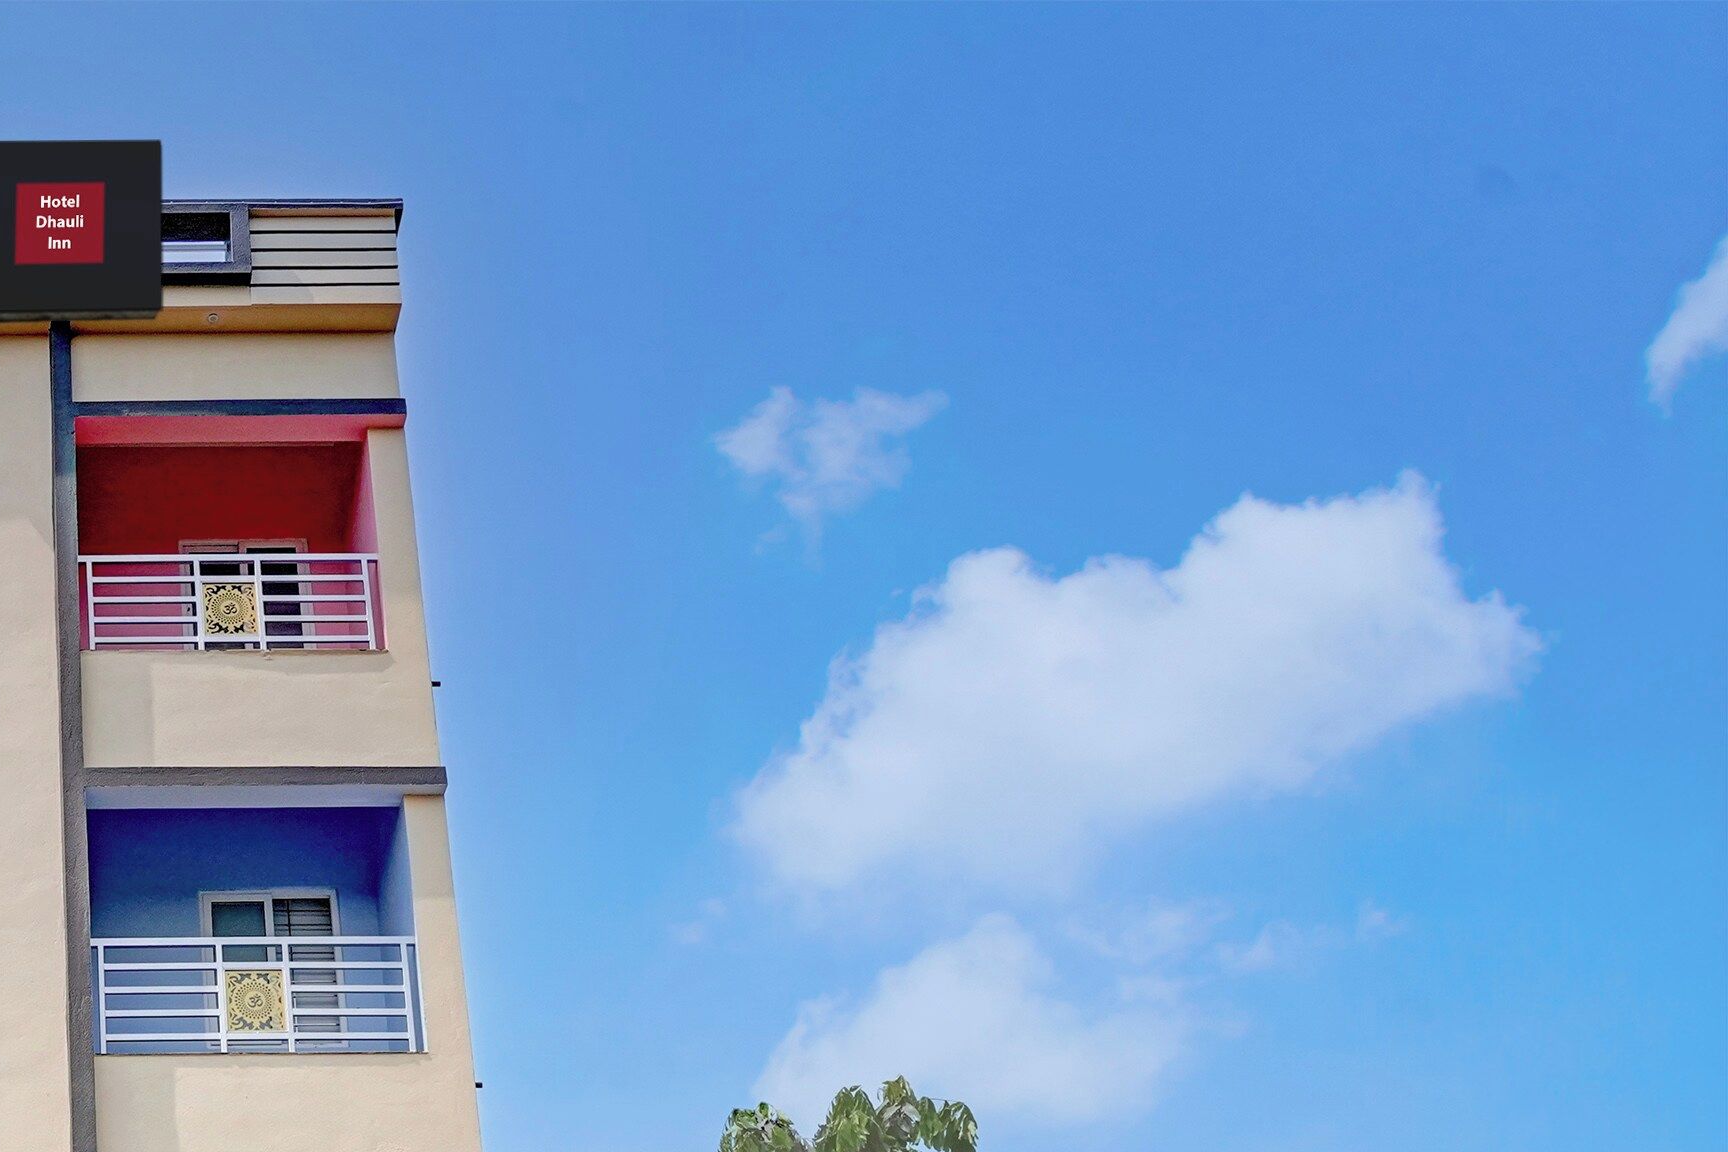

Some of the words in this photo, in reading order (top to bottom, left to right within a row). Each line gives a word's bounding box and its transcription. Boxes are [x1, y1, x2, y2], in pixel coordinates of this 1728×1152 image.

[40, 194, 80, 208] Hotel
[36, 215, 84, 228] Dhauli
[48, 236, 71, 249] Inn
